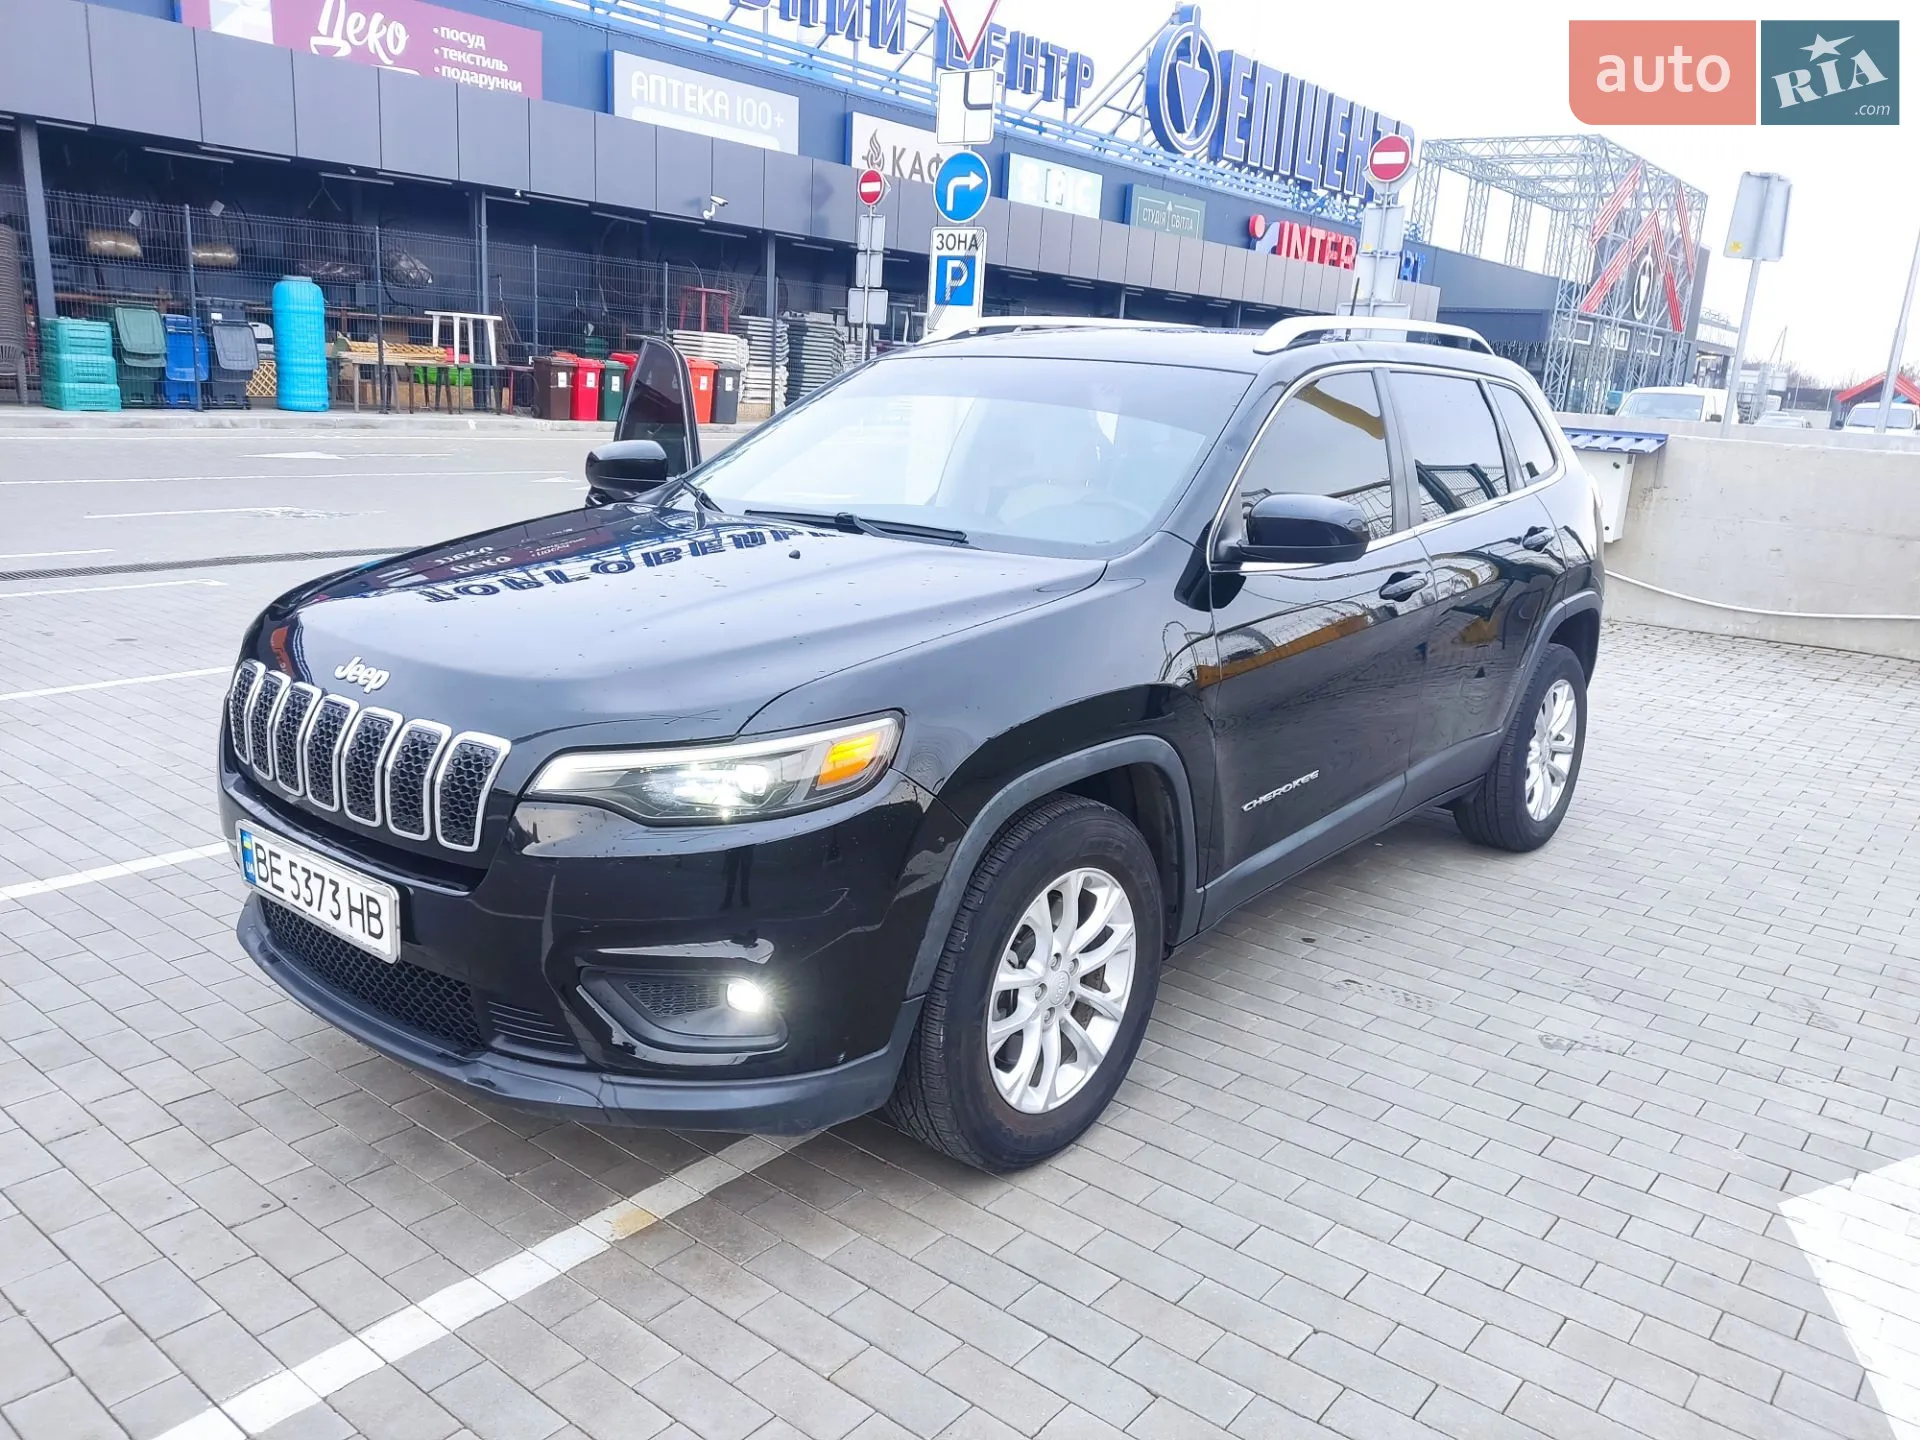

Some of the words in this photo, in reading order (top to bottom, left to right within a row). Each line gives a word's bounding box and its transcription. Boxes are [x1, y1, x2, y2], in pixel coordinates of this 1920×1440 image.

[309, 0, 410, 65] Деко
[440, 26, 486, 50] посуд
[440, 46, 509, 72] текстиль
[441, 65, 522, 92] подарунки
[631, 70, 730, 121] АПТЕКА
[736, 95, 785, 130] 100+
[936, 233, 979, 251] ЗОНА
[945, 259, 969, 302] P
[334, 656, 390, 693] Jeep
[1241, 769, 1320, 812] CHEROKEE
[253, 842, 285, 893] BE
[288, 860, 342, 921] 5373
[346, 886, 385, 940] HB
